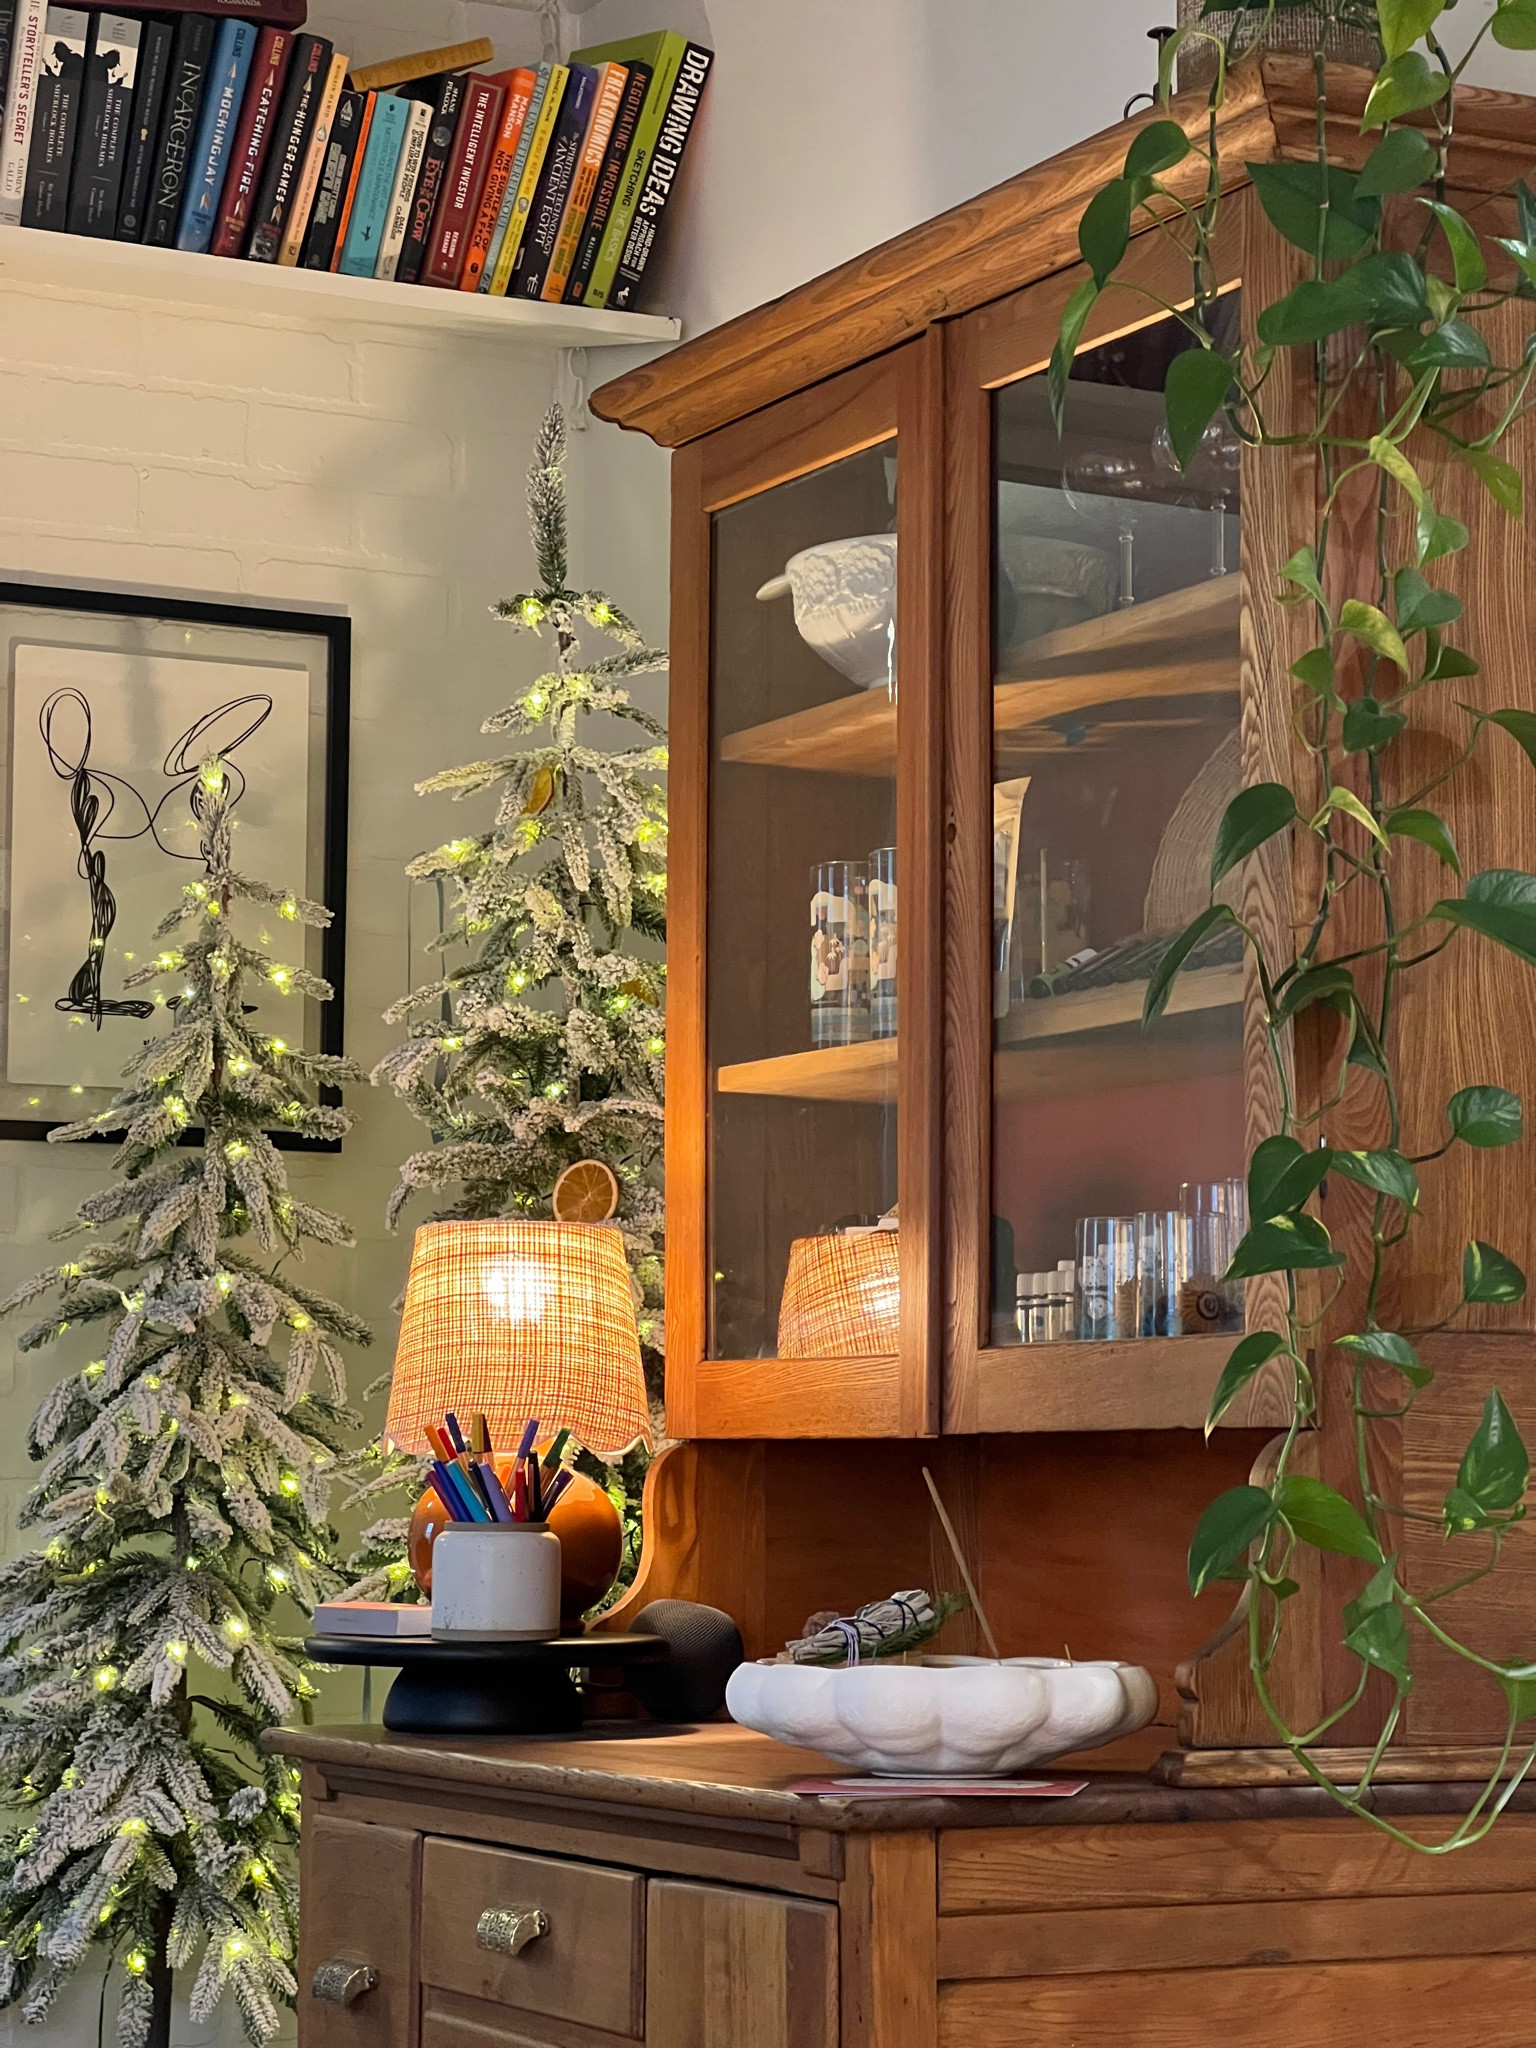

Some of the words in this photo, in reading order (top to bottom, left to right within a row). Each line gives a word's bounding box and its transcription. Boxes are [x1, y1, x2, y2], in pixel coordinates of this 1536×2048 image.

[19, 16, 37, 99] STORYTELLER'S
[233, 28, 245, 57] COLLINS
[270, 36, 284, 65] COLLINS
[308, 43, 323, 73] COLLINS
[331, 65, 341, 92] MOHSIN
[531, 83, 545, 107] THE
[552, 71, 562, 94] DANIEL
[51, 83, 60, 126] SHERLOCK
[103, 89, 114, 131] SHERLOCK
[300, 93, 309, 108] THE
[324, 94, 333, 117] HAMID
[441, 81, 453, 115] PEACOCK
[448, 88, 458, 113] SHANE
[477, 92, 489, 108] THE
[515, 97, 528, 126] MARK
[615, 73, 646, 151] NEGOTIATING
[658, 49, 710, 154] DRAWING
[14, 104, 27, 144] SECRET
[248, 88, 272, 157] CATCHING
[503, 94, 521, 138] MANSON
[584, 69, 625, 166] FREAKONOMICS
[46, 129, 55, 163] HOLMES
[56, 112, 66, 157] COMPLETE
[98, 134, 107, 167] HOLMES
[108, 117, 119, 161] COMPLETE
[157, 61, 201, 208] INCARCERON
[204, 87, 234, 185] MOCKINGJAY
[286, 110, 306, 160] HUNGER
[416, 131, 424, 148] HOW
[464, 110, 485, 164] INTELLIGENT
[405, 136, 417, 172] INFLUENCE
[410, 159, 418, 173] WIN
[494, 150, 505, 171] NOT
[502, 154, 512, 173] THE
[506, 111, 537, 196] UNTETHERED
[559, 141, 577, 191] SPIRITUAL
[6, 162, 14, 191] GALLO
[15, 159, 24, 194] CARMINE
[239, 162, 254, 194] FIRE
[275, 163, 292, 203] GAMES
[399, 173, 409, 198] PEOPLE
[404, 175, 414, 202] FRIENDS
[423, 157, 440, 188] EYE
[454, 167, 472, 209] INVESTOR
[545, 142, 568, 203] ANCIENT
[621, 149, 646, 207] SKETCHING
[639, 154, 677, 217] IDEAS
[483, 174, 499, 210] GIVING
[492, 174, 507, 212] SUBTLE
[591, 158, 621, 230] IMPOSSIBLE
[390, 206, 401, 239] CARNEGIE
[397, 217, 405, 234] DALE
[412, 198, 432, 242] CROW
[480, 212, 488, 221] A
[486, 215, 496, 236] ART
[496, 198, 512, 230] SOUL
[534, 205, 552, 246] EGYPT
[542, 193, 564, 256] TECHNOLOGY
[615, 209, 627, 228] THE
[630, 216, 643, 240] BETTER
[442, 231, 451, 253] GRAHAM
[448, 231, 459, 258] BENJAMIN
[481, 237, 489, 252] OF
[604, 228, 621, 263] BASICS
[623, 240, 635, 264] DESIGN
[633, 220, 650, 256] APPROACH
[637, 228, 655, 271] HAND-DRAWN
